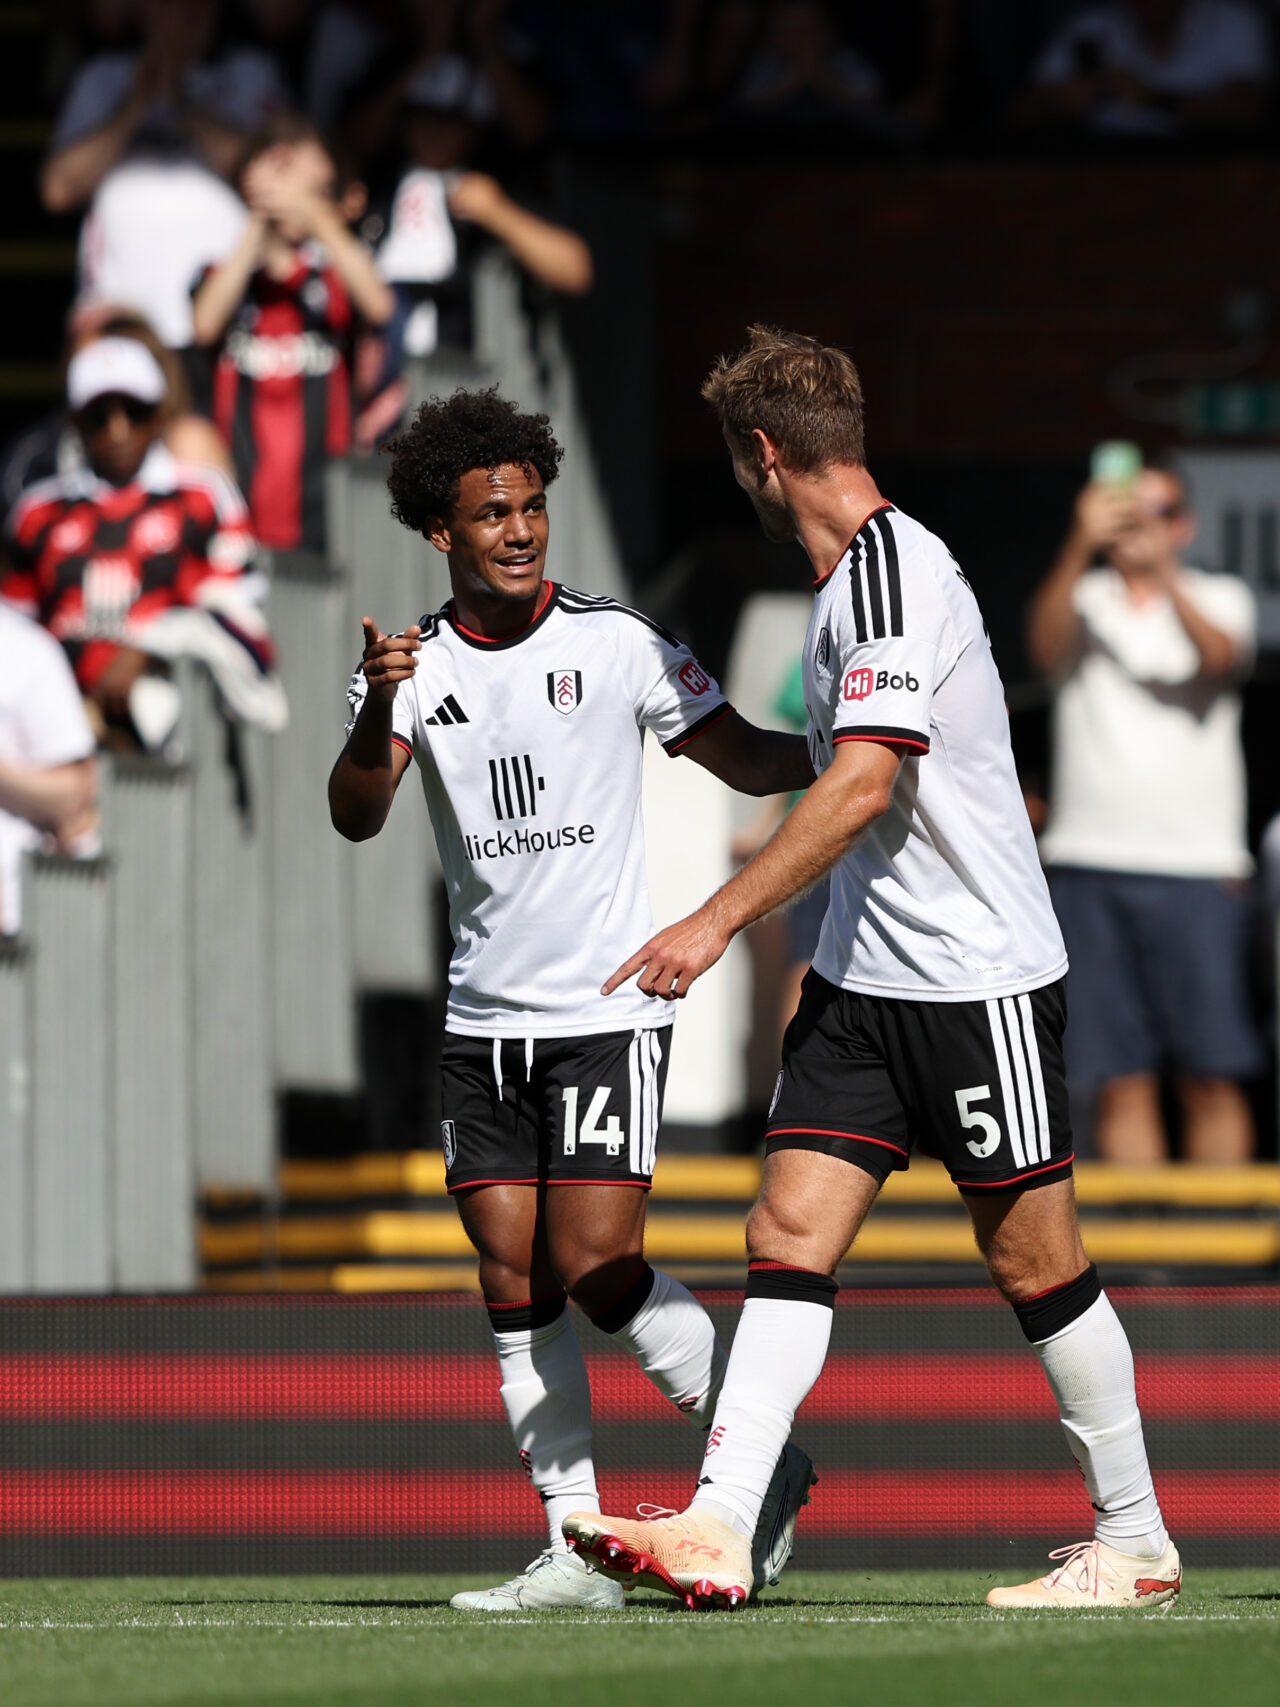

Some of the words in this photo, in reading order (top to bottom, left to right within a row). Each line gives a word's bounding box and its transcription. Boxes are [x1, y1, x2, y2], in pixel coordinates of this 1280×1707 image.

[460, 823, 596, 861] lickHouse
[561, 1086, 625, 1156] 14
[954, 1084, 1001, 1159] 5
